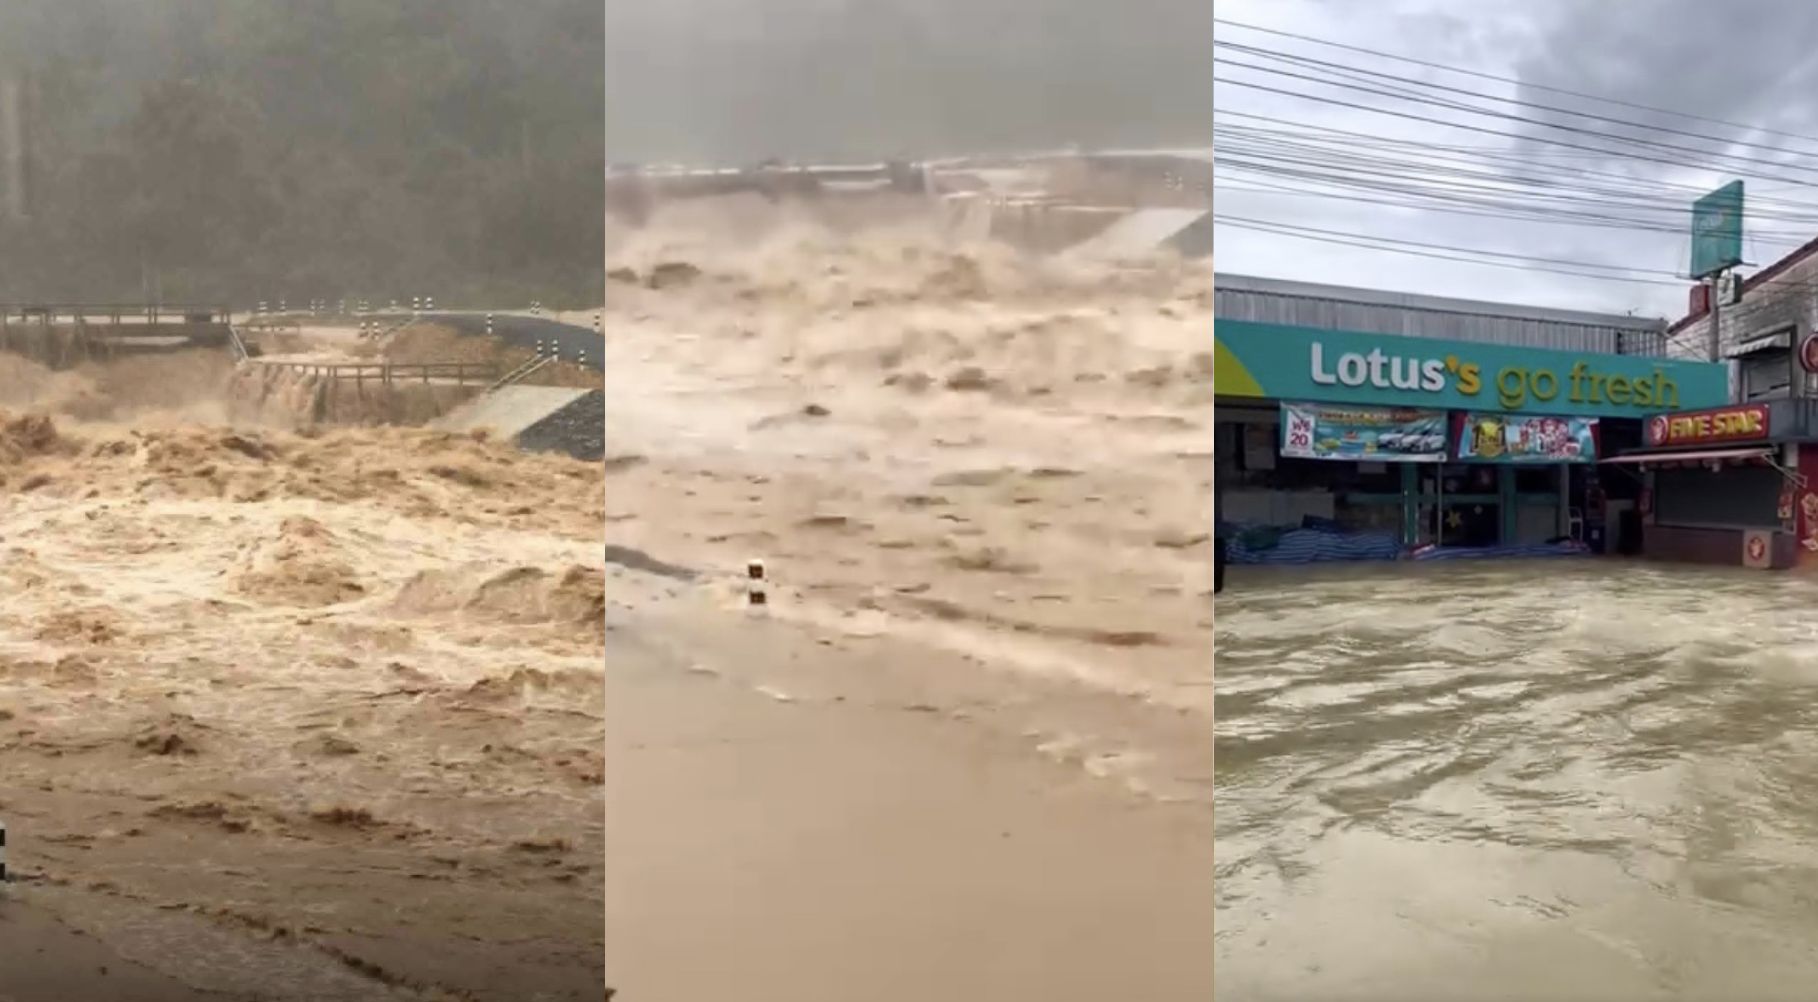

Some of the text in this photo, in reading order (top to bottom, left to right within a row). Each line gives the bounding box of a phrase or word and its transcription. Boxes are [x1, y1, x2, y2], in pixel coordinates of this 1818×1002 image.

[1310, 342, 1678, 408] Lotus's go fresh
[1669, 410, 1763, 438] FIVE STAR
[1290, 433, 1308, 447] 20
